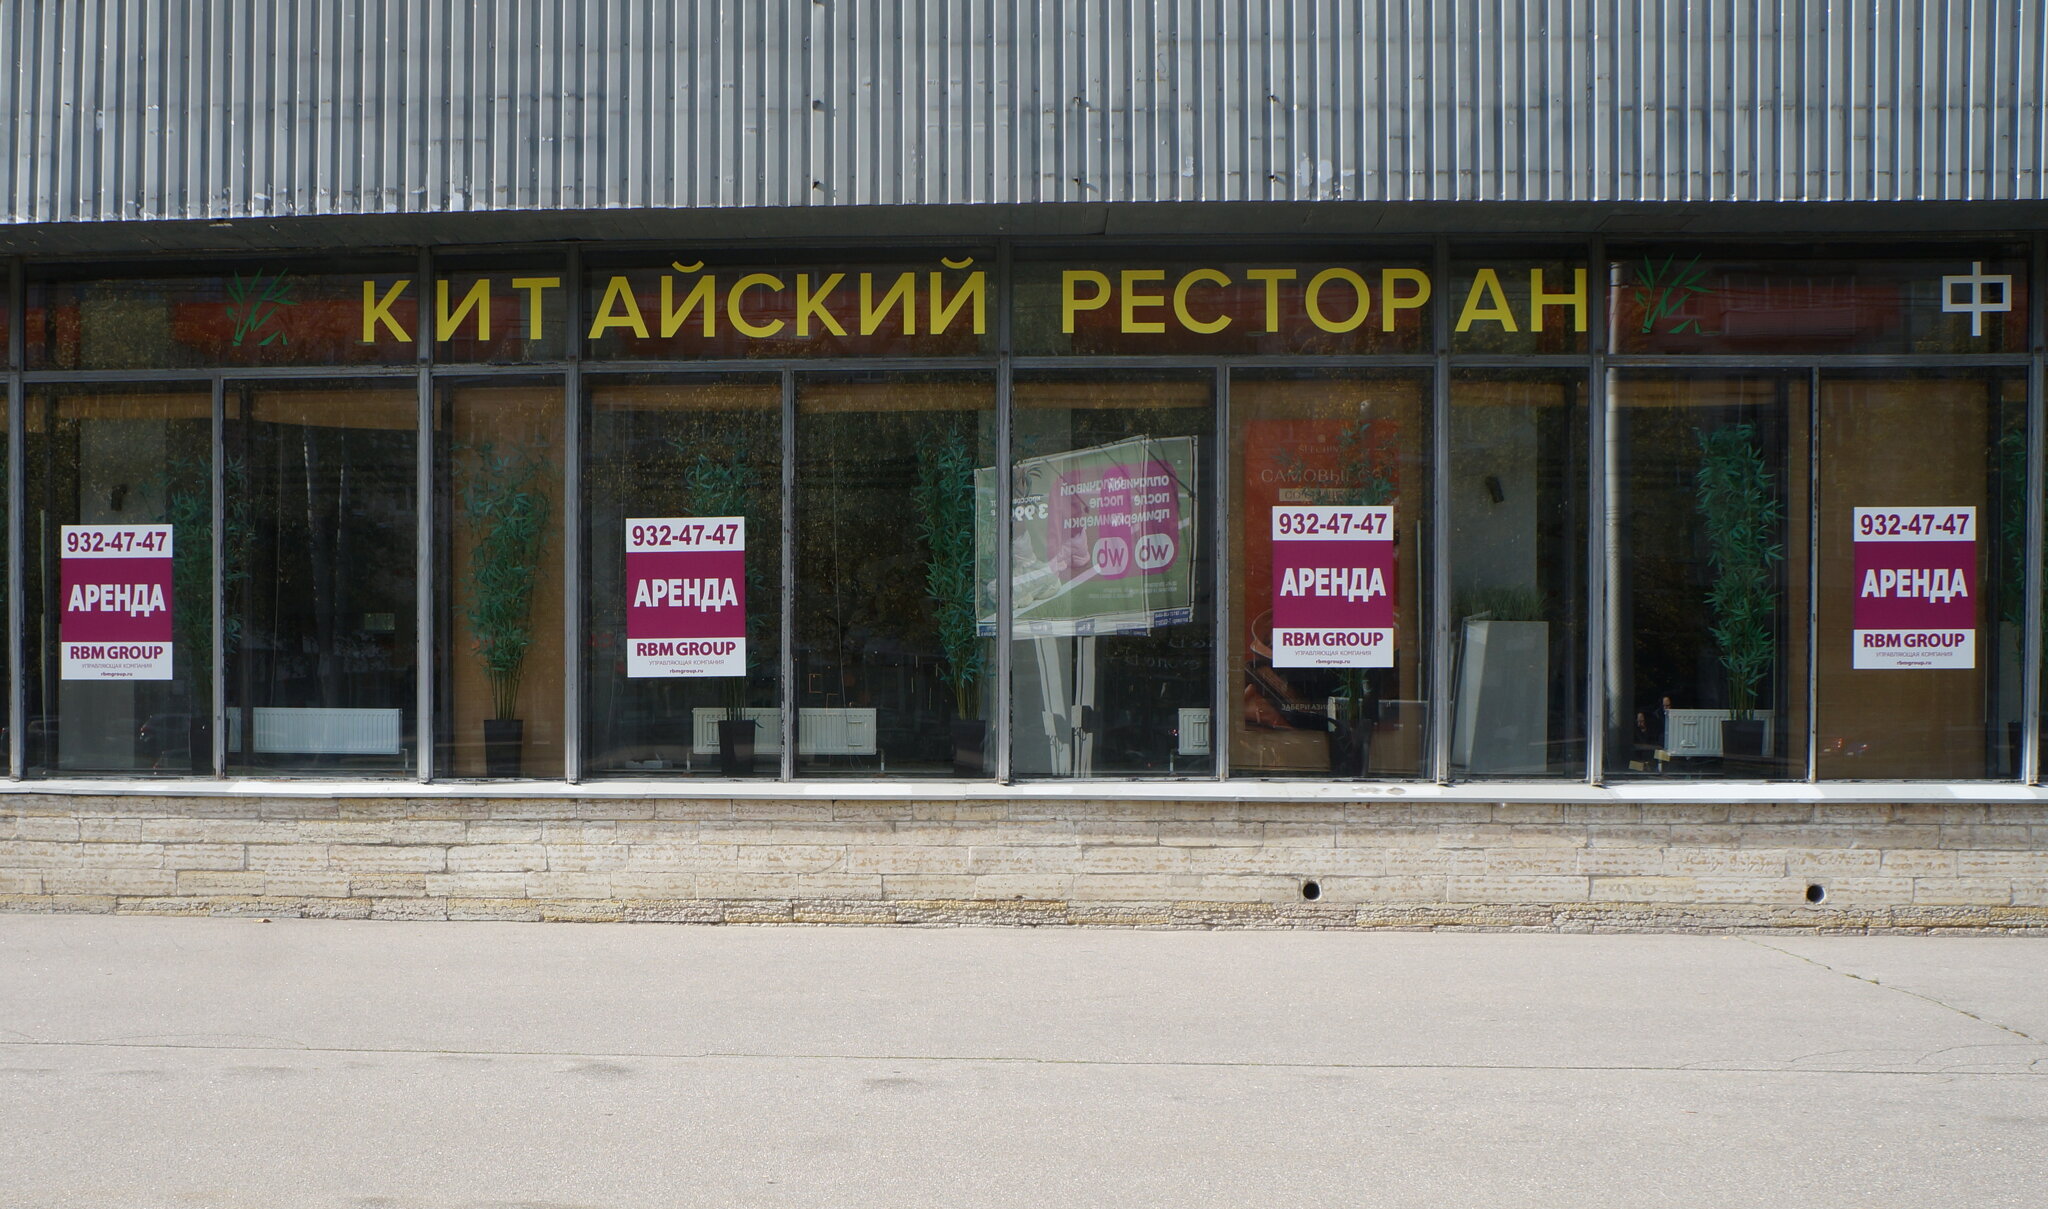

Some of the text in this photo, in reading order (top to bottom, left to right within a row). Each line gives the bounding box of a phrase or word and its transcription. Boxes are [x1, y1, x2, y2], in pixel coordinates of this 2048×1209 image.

[363, 258, 1586, 342] КИТАЙСКИЙ РЕСТОРАН
[1942, 262, 2012, 337] 中
[632, 524, 739, 546] 932-47-47
[1279, 513, 1387, 535] 932-47-47
[1860, 514, 1970, 536] 932-47-47
[67, 532, 167, 552] 932-47-47
[633, 578, 739, 612] АРЕНДА
[1280, 568, 1387, 602] АРЕНДА
[1861, 568, 1969, 603] АРЕНДА
[68, 584, 166, 617] АРЕНДА
[637, 641, 736, 656] RBM GROUP
[1282, 632, 1384, 646] RBM GROUP
[1863, 633, 1965, 648] RBM GROUP
[70, 646, 163, 660] RBM GROUP
